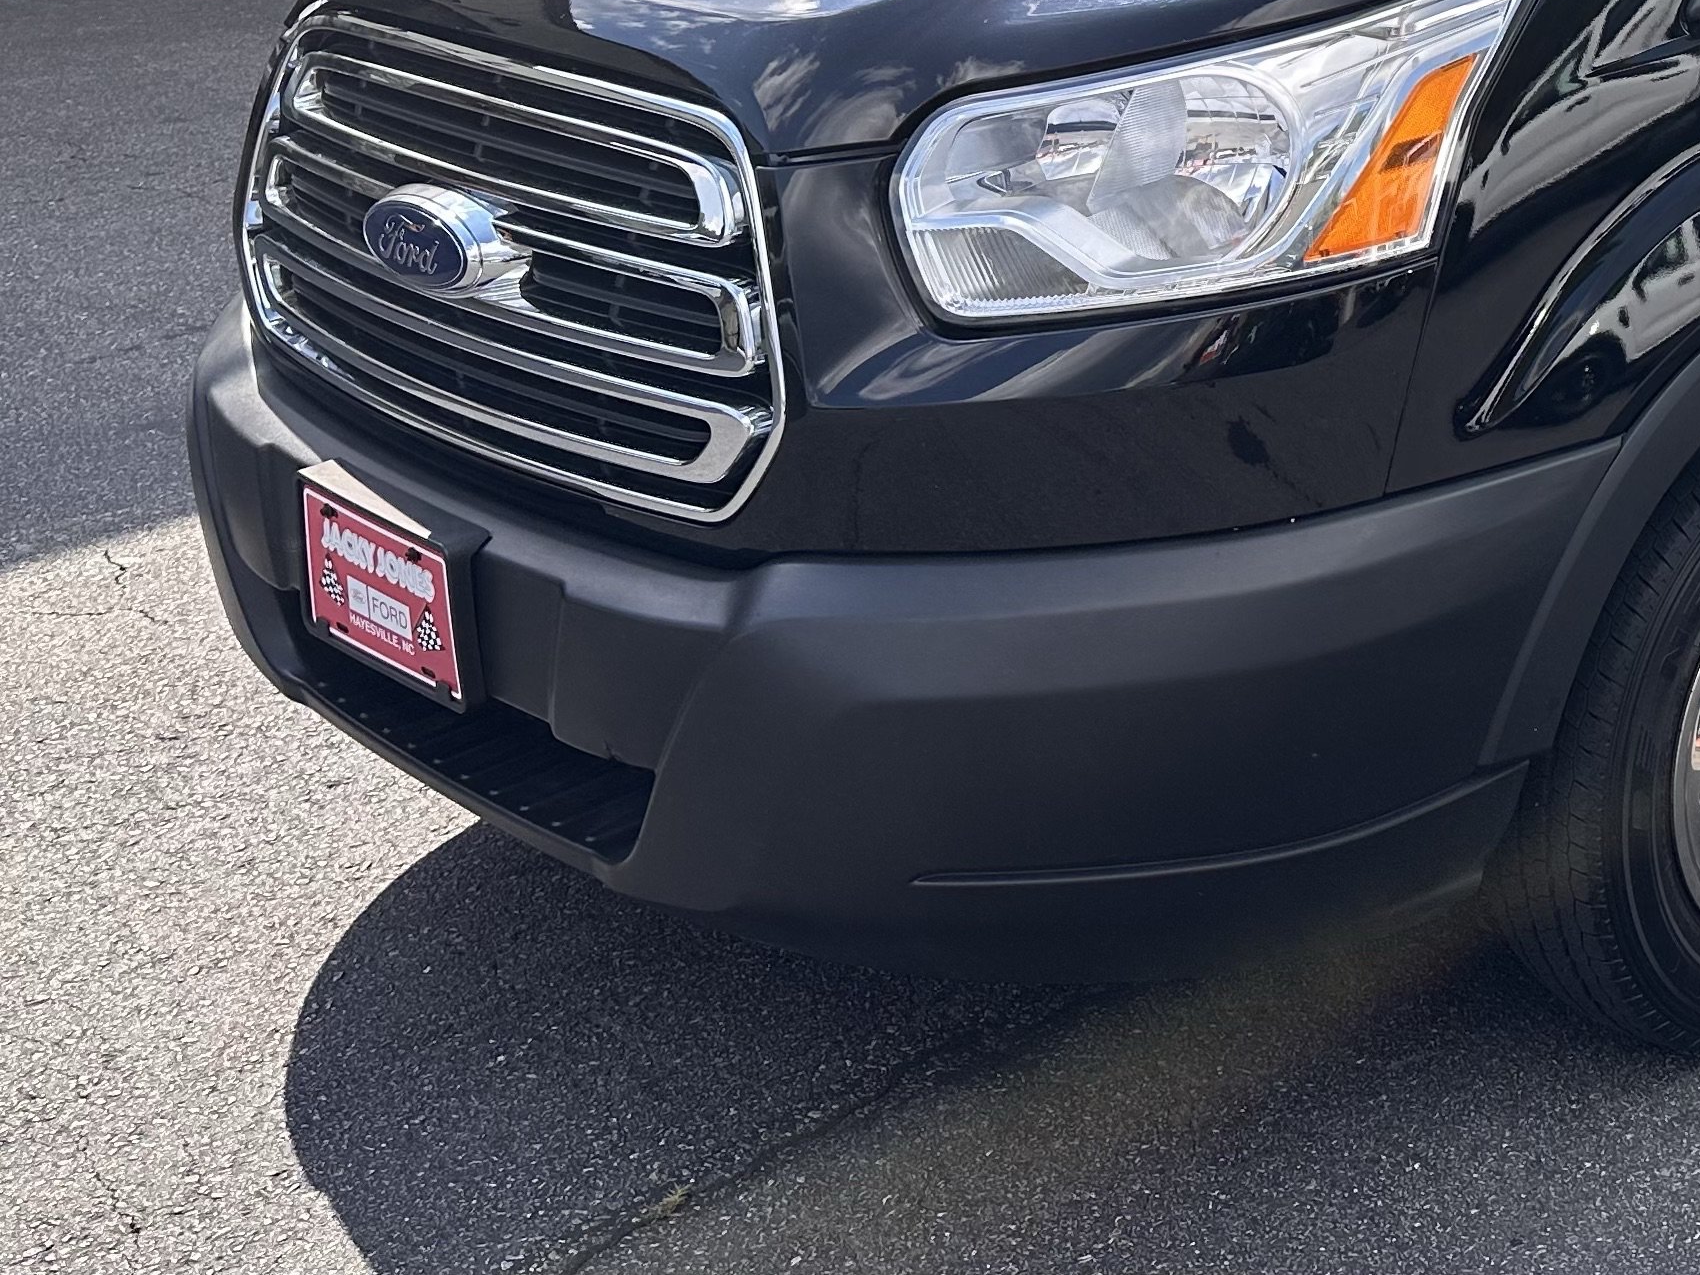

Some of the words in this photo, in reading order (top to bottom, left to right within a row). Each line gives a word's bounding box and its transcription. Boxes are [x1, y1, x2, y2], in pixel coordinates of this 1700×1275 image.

[378, 213, 440, 275] Ford
[321, 517, 376, 574] JACKY
[375, 547, 436, 603] JONES
[350, 613, 401, 650] HAYESVILLE,
[401, 640, 415, 656] NC
[371, 596, 408, 630] FORD
